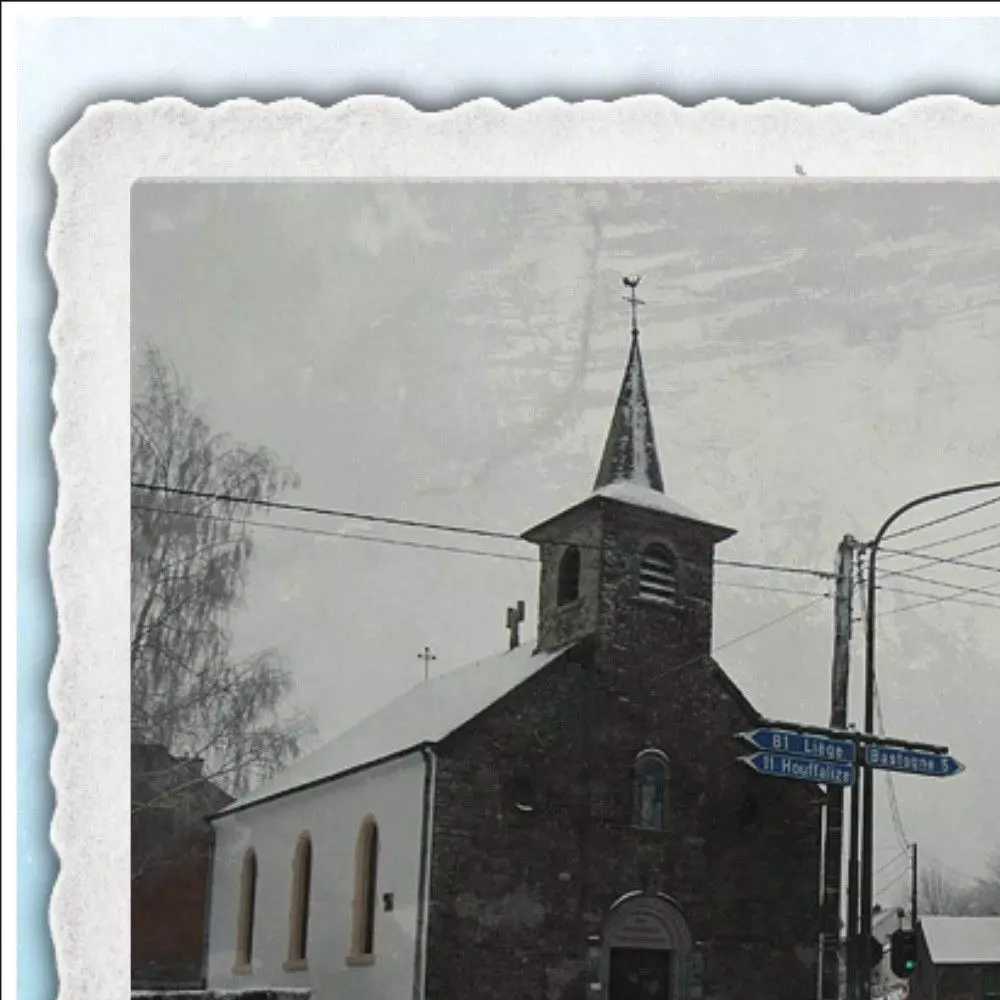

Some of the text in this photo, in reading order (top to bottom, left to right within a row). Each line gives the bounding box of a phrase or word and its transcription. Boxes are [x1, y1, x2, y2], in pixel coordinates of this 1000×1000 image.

[772, 733, 788, 751] 81
[763, 755, 850, 783] 11 Houffalize
[871, 745, 950, 772] Bastogne 5
